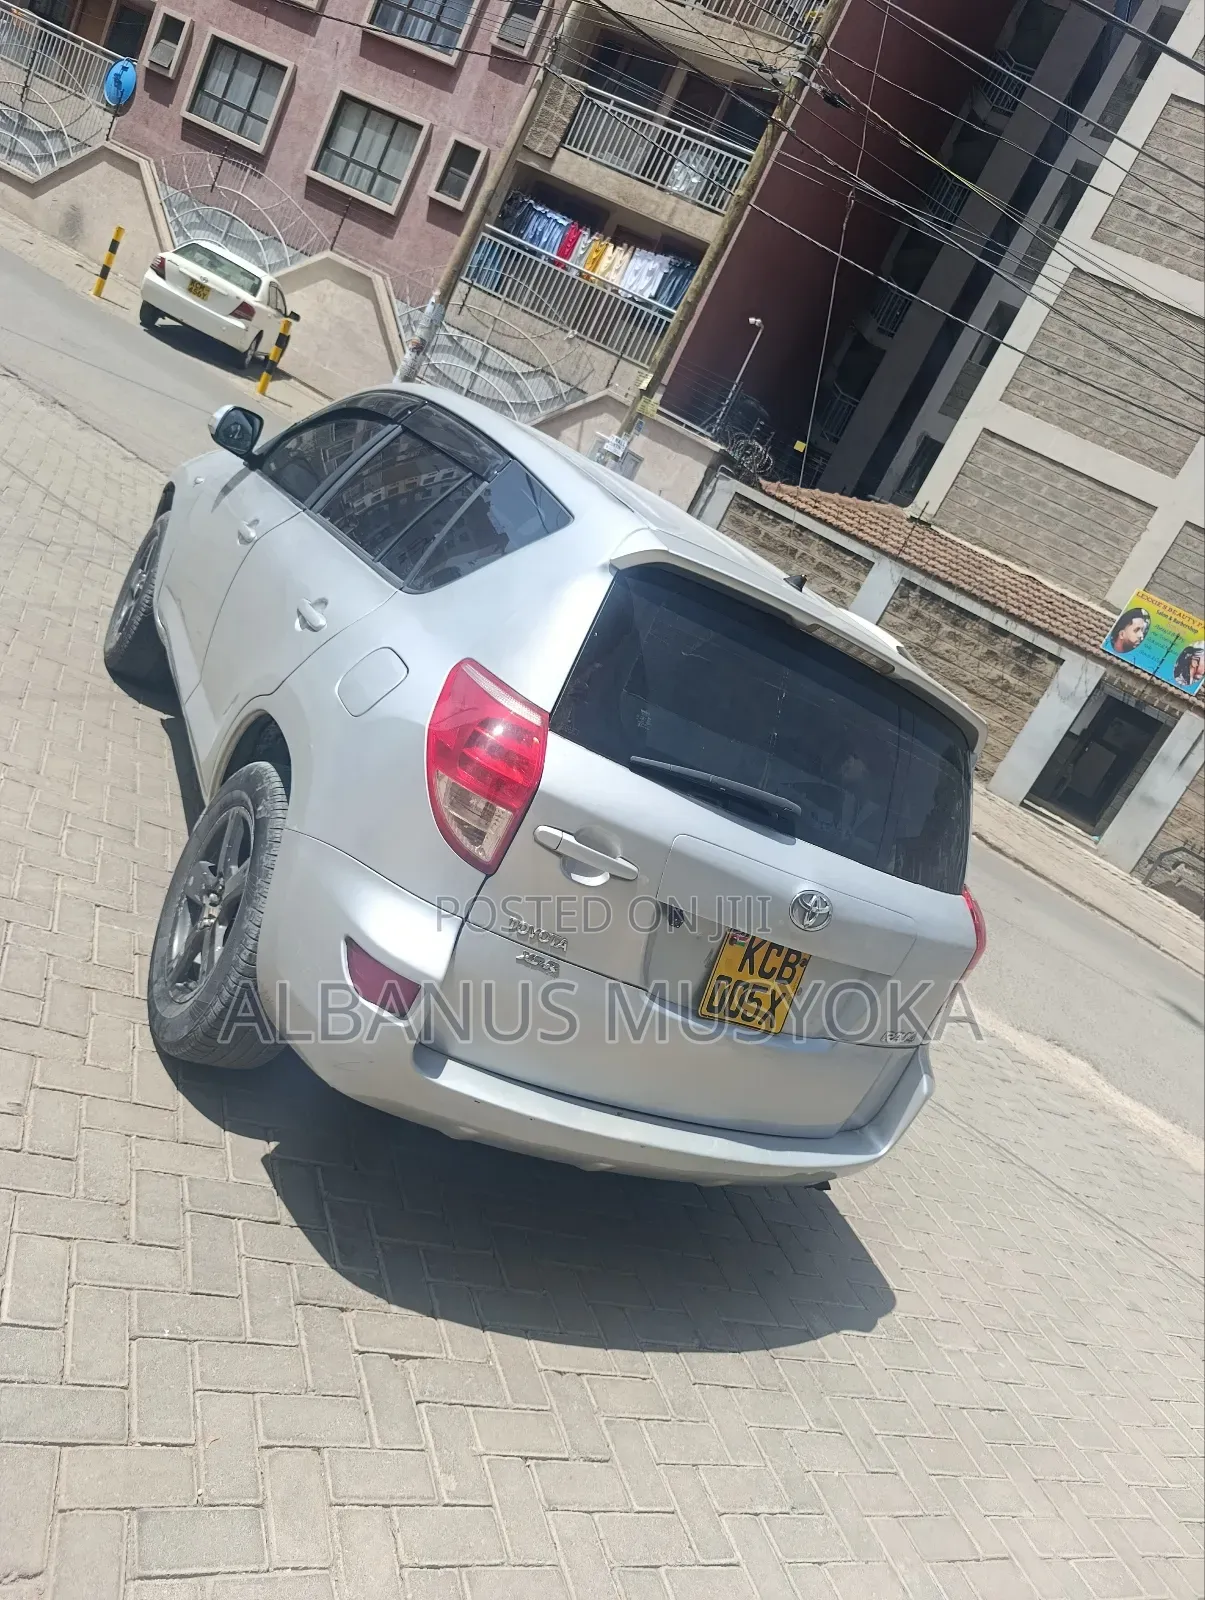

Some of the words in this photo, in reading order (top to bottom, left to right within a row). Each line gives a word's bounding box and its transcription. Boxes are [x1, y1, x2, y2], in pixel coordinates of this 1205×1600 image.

[1136, 591, 1167, 610] LEXXIE'S
[1167, 607, 1197, 625] BEAUTY
[1156, 609, 1168, 619] Salon
[1173, 617, 1199, 634] Barbershop
[509, 916, 568, 951] TOYOTA
[738, 936, 802, 985] KCB
[706, 975, 787, 1029] 005X
